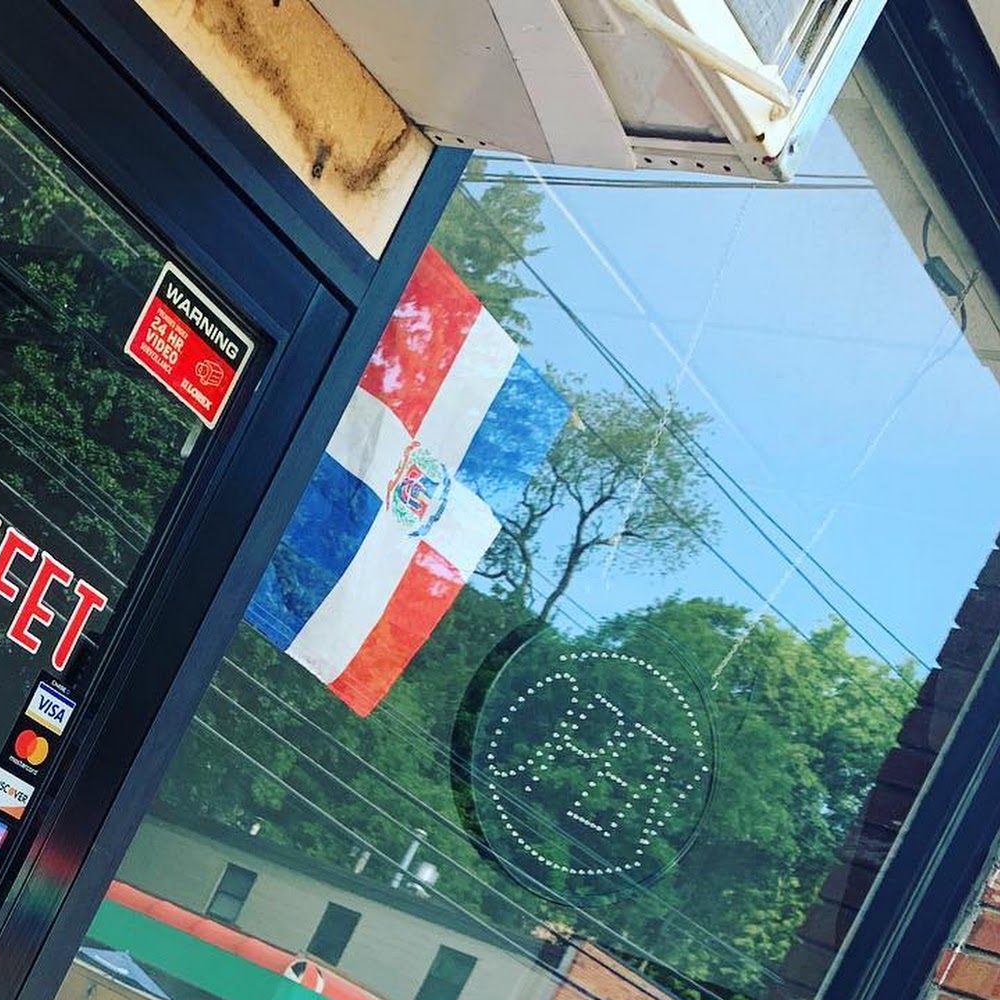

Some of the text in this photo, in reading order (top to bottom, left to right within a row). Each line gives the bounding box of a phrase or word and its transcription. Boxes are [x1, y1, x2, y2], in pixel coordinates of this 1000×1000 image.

[151, 315, 185, 352] 24 HR
[165, 282, 239, 360] WARNING
[145, 328, 179, 365] VIDEO
[38, 694, 66, 723] VISA
